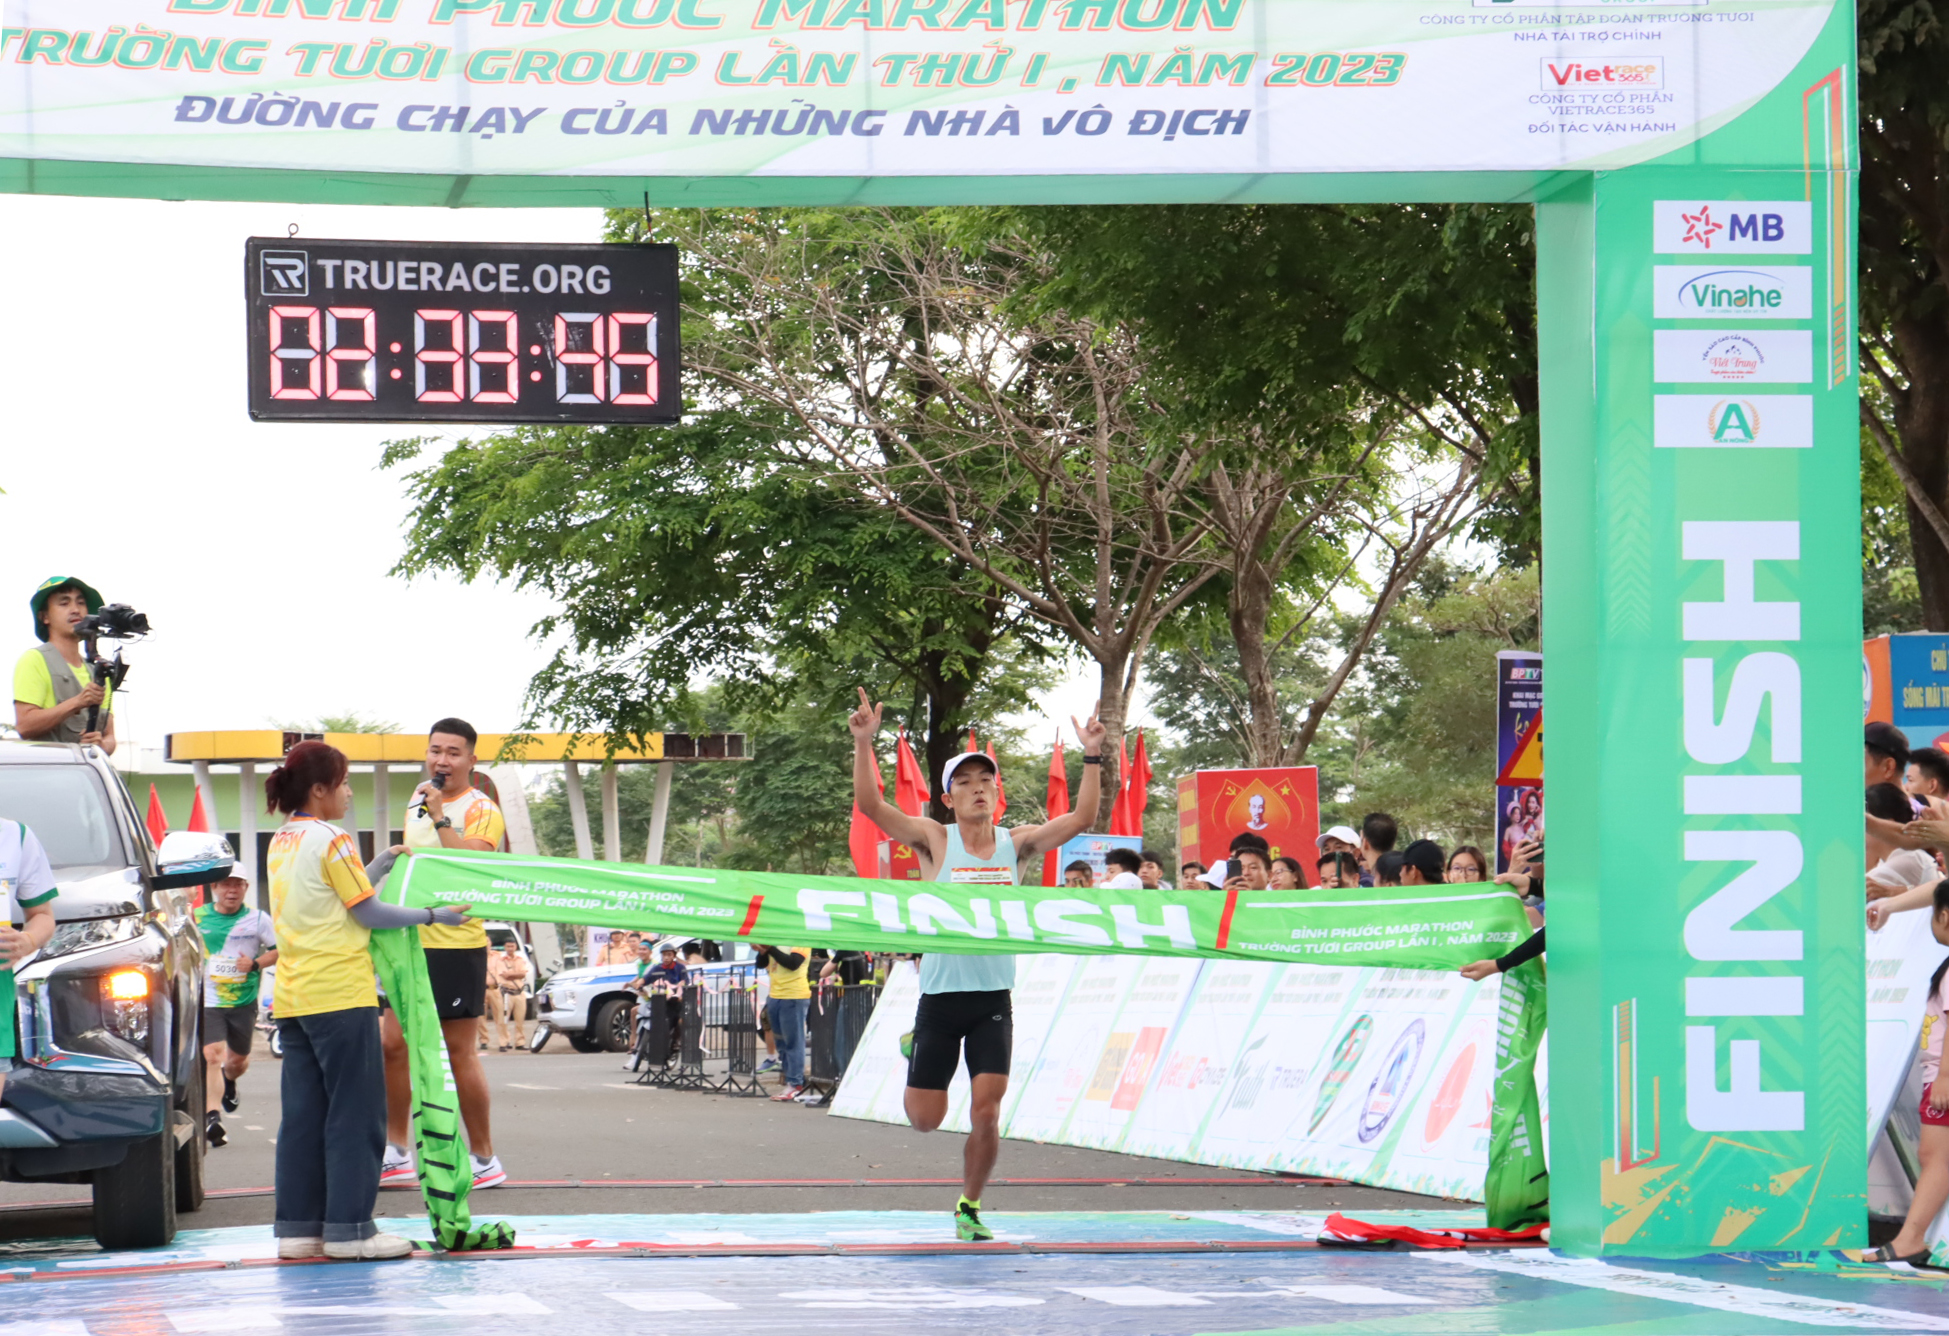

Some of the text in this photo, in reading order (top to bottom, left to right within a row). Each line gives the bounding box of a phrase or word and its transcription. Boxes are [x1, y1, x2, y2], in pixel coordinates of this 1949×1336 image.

[750, 0, 1246, 31] MARATHON
[1468, 15, 1488, 24] TY
[1612, 28, 1662, 41] CHÍNH
[286, 37, 450, 82] TƯƠI
[465, 48, 700, 85] GROUP
[715, 37, 860, 86] LẦN
[873, 38, 1016, 87] THỨ
[1095, 44, 1258, 87] NĂM
[1264, 52, 1408, 88] 2023
[1547, 62, 1615, 86] Viet
[1548, 105, 1655, 115] VIETRACE365
[1578, 94, 1599, 104] TY
[174, 91, 1252, 142] ĐƯỜNG CHẠY CỦA NHỮNG NHÀ VÔ ĐỊCH
[1559, 120, 1589, 133] TÁC
[1729, 213, 1785, 242] MB
[317, 259, 611, 295] TRUERACE.ORG
[1691, 284, 1782, 308] Vinahe
[269, 305, 659, 405] 02:33:45
[1682, 520, 1805, 1131] FINISH
[545, 897, 601, 909] GROUP
[697, 907, 735, 917] 2023
[796, 888, 1197, 950] FINISH
[1291, 920, 1474, 939] BÌNH PHƯỚC MARATHON
[1343, 939, 1396, 952] GROUP
[1485, 931, 1518, 943] 2023
